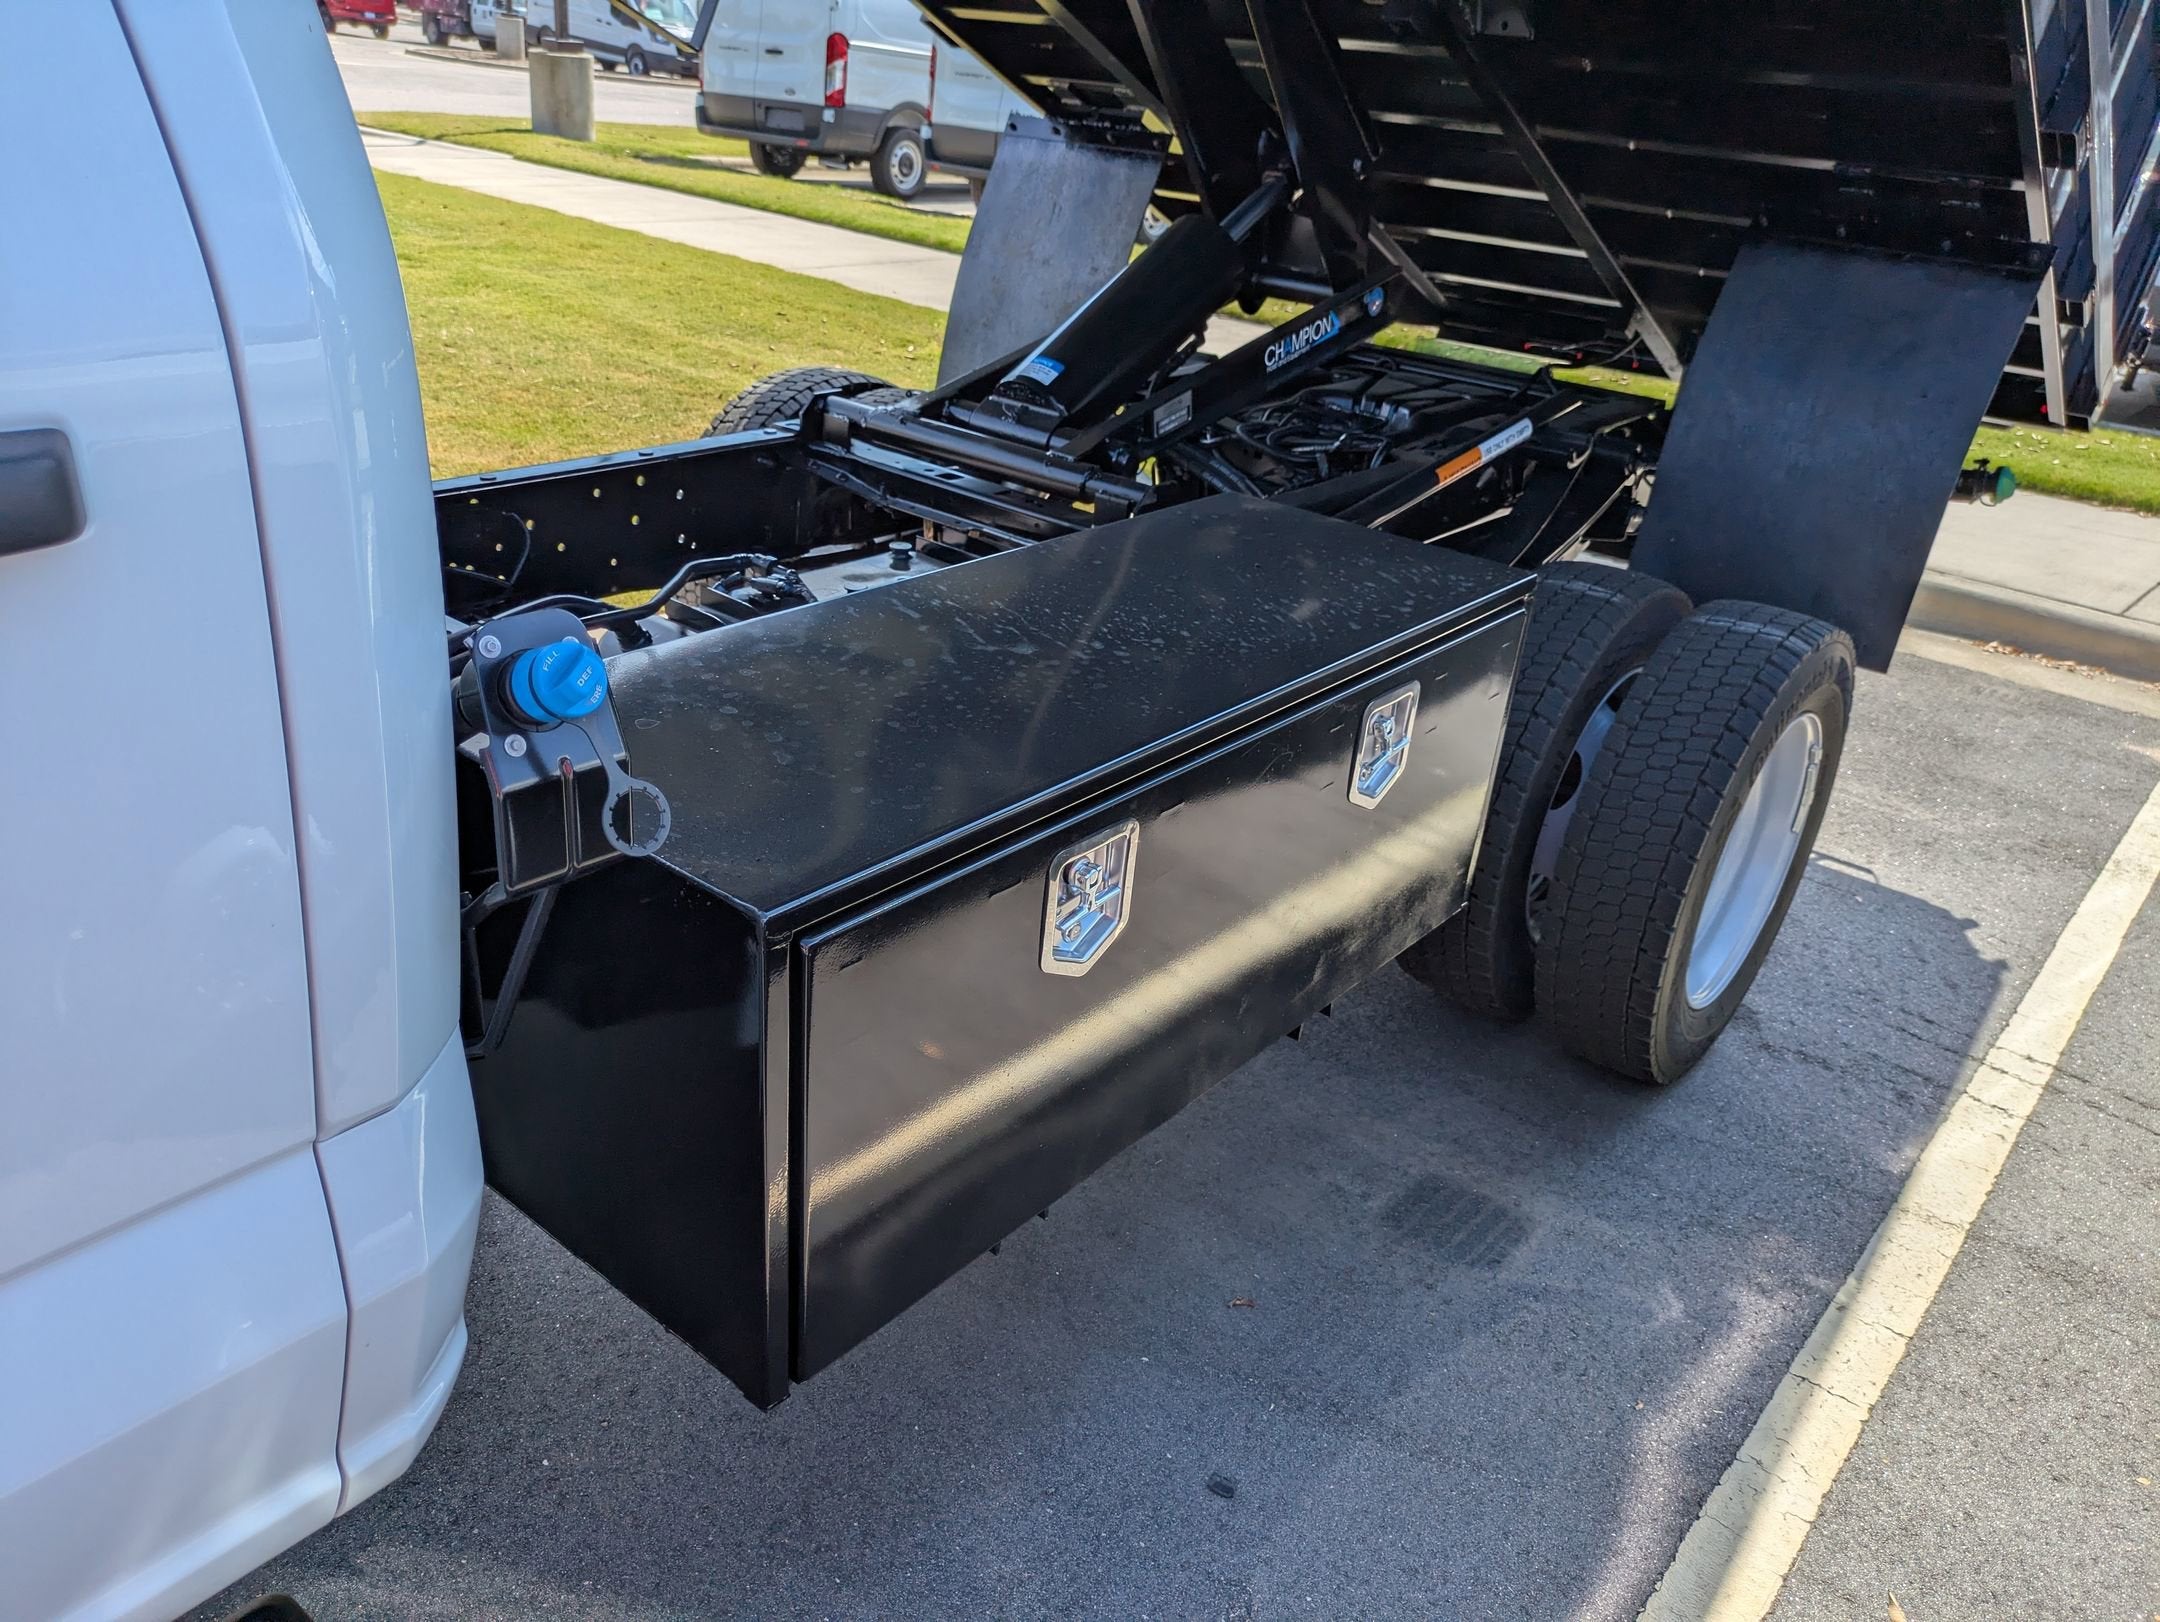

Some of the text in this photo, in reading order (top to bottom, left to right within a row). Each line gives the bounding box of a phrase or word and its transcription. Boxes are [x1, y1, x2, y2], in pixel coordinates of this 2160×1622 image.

[1264, 316, 1331, 367] CHAMPION
[577, 666, 593, 687] DEF
[588, 684, 603, 705] ERE
